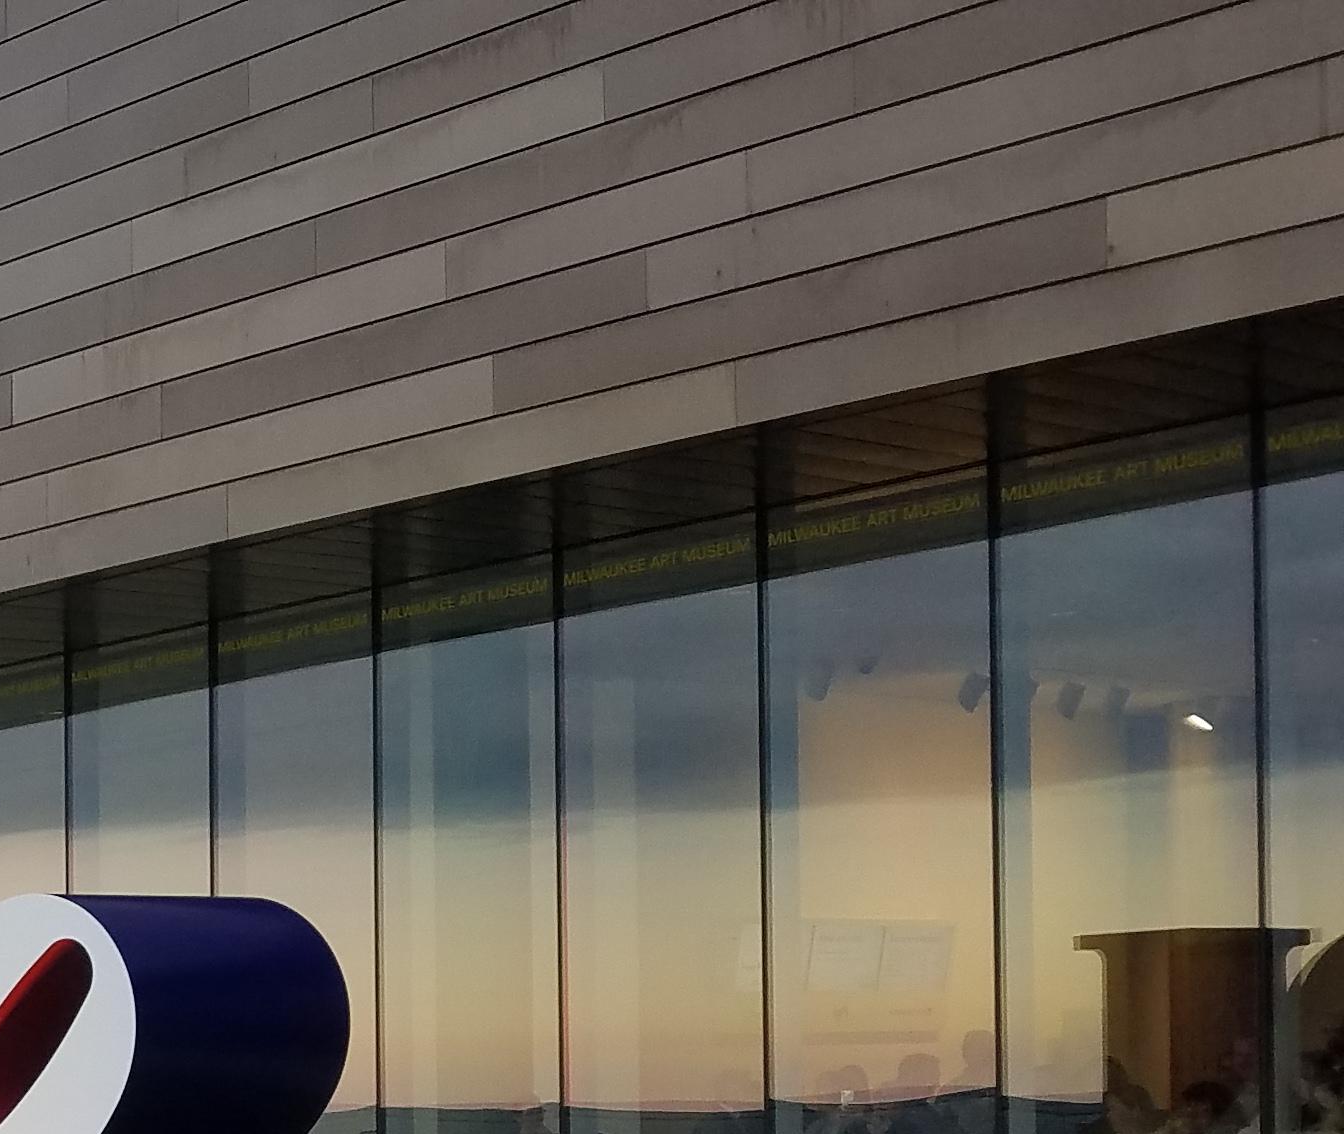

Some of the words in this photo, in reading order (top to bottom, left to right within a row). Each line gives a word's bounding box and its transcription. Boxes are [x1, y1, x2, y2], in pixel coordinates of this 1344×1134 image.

[1001, 470, 1105, 503] MILWAUKEE
[1114, 461, 1149, 481] ART
[1155, 439, 1244, 473] MUSEUM
[767, 516, 861, 547] MILWAUKEE
[867, 509, 897, 528] ART
[904, 493, 981, 521] MUSEUM
[564, 558, 647, 587] MILWAUKEE
[650, 552, 676, 569] ART
[682, 537, 751, 562] MUSEUM
[381, 597, 455, 622] MILWAUKEE
[459, 590, 484, 607] ART
[488, 577, 548, 601] MUSEUM
